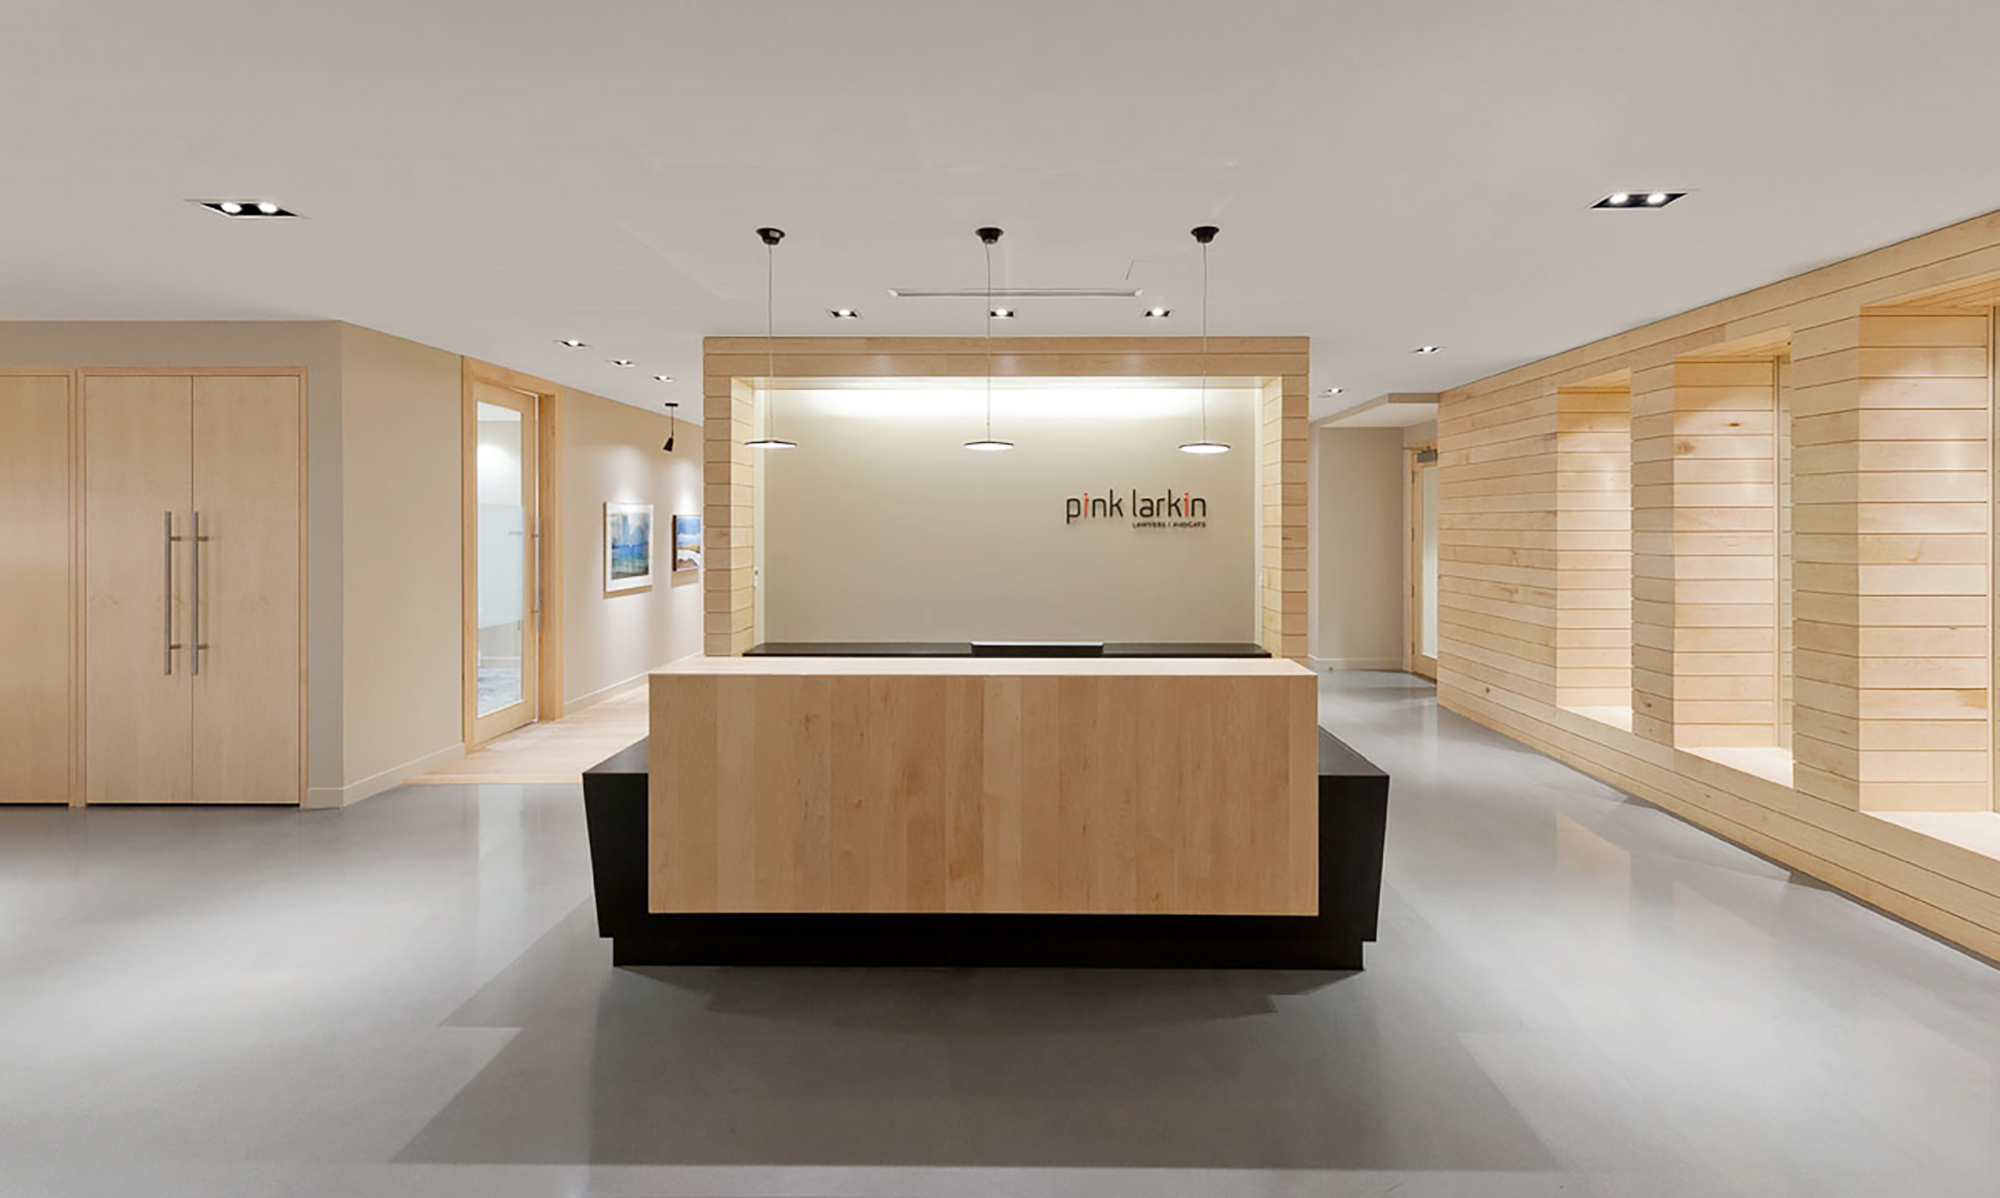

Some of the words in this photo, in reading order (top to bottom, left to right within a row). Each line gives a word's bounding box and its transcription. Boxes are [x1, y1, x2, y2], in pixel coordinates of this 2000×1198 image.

[1066, 488, 1124, 525] pink
[1132, 488, 1206, 518] larkin
[1132, 521, 1166, 529] LAWYERS
